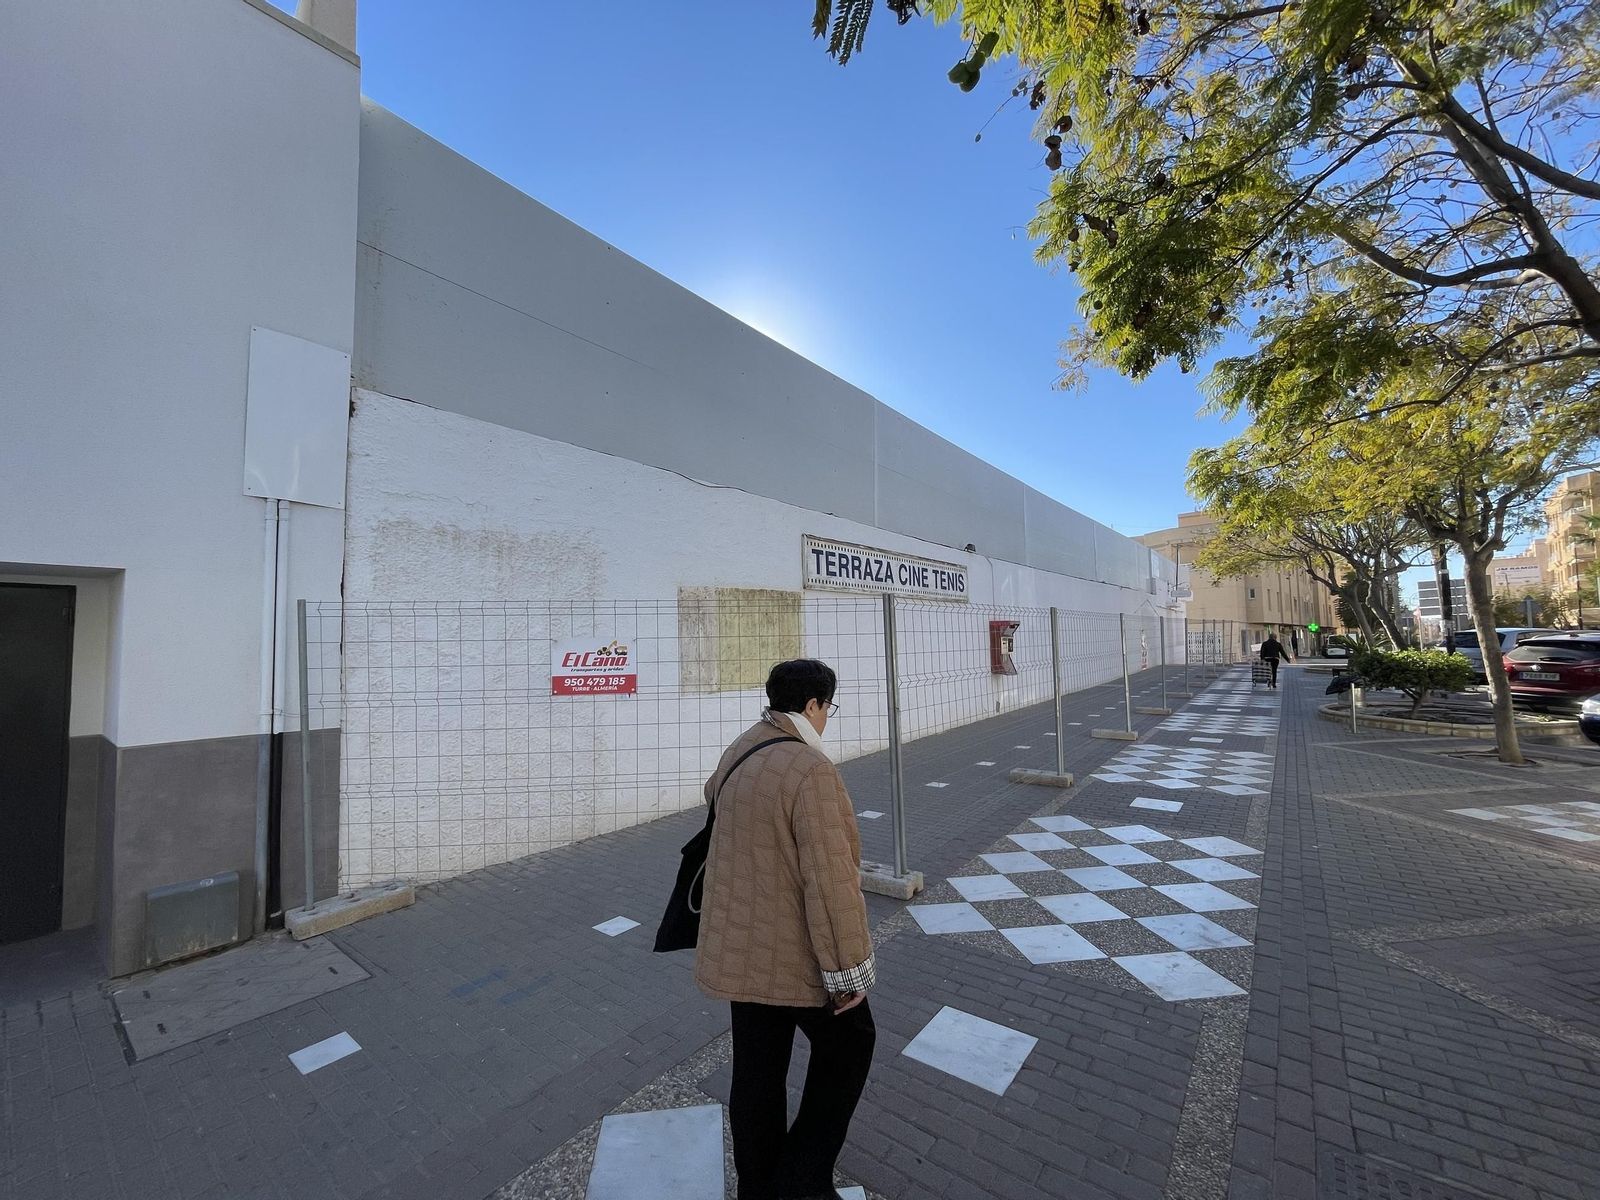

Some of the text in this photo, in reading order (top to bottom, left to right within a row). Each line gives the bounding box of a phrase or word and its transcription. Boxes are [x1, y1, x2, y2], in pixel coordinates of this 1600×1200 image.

[811, 548, 965, 592] TERRAZA CINE TENIS
[564, 676, 626, 687] 950 479 185
